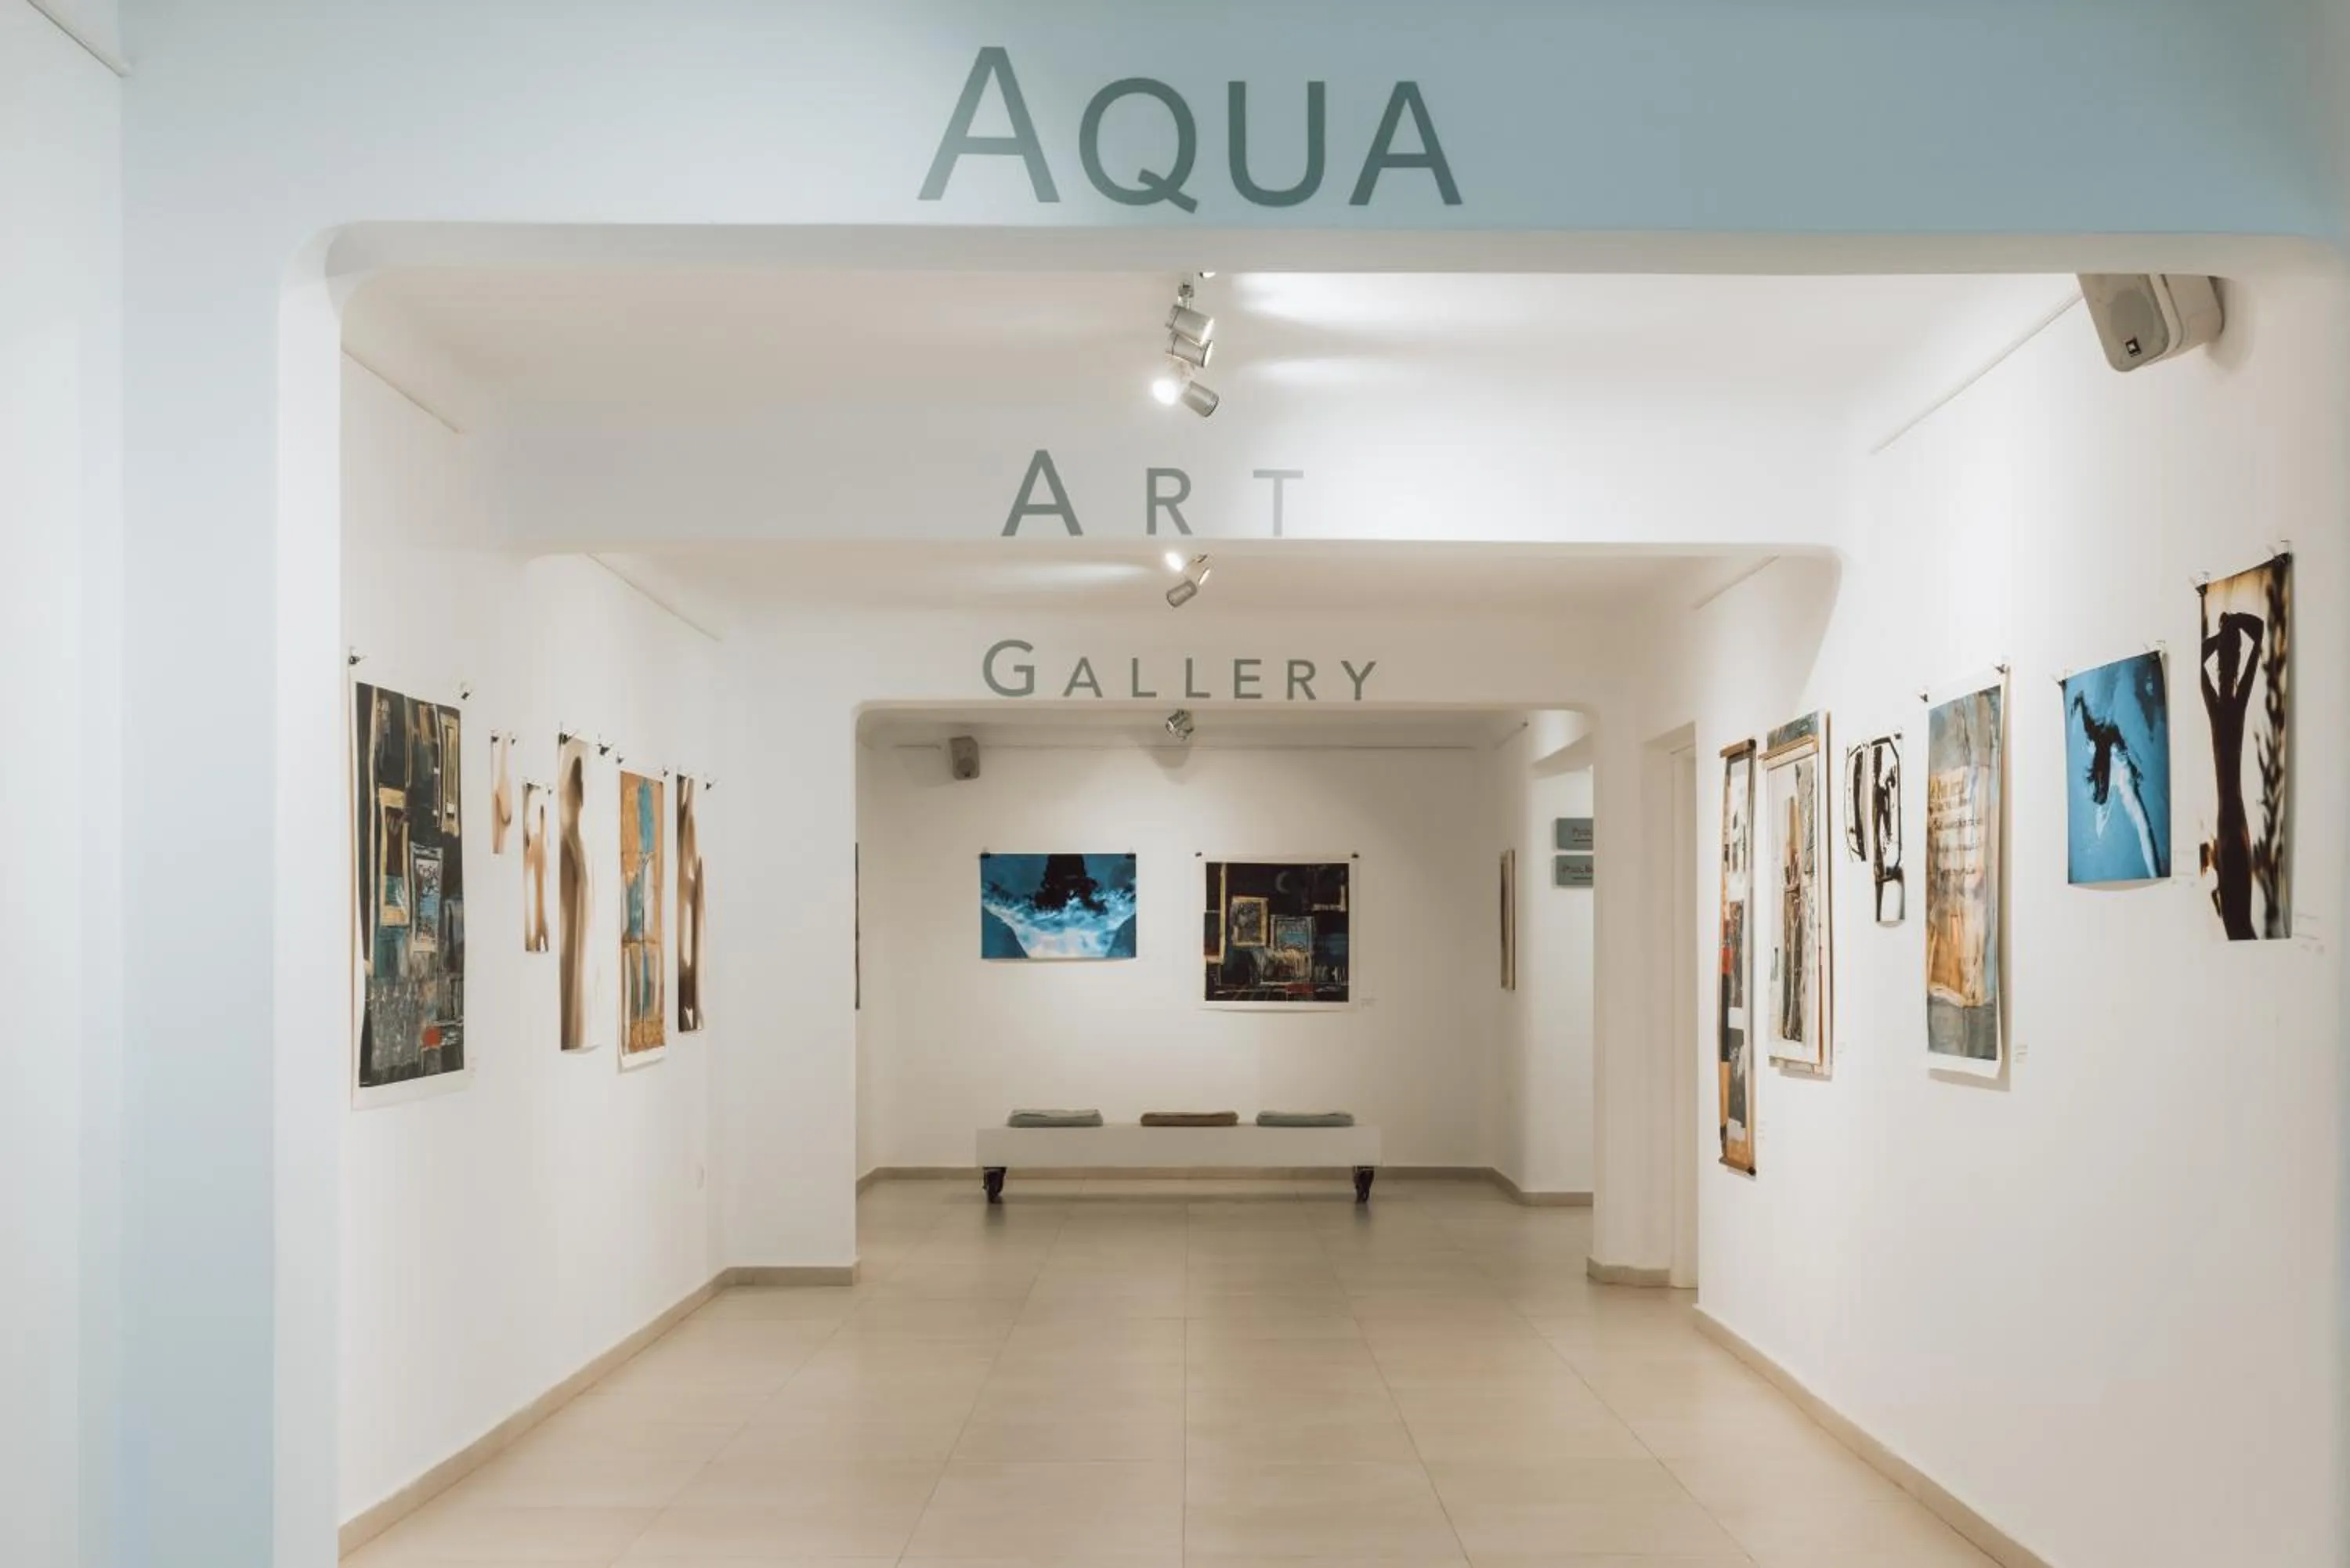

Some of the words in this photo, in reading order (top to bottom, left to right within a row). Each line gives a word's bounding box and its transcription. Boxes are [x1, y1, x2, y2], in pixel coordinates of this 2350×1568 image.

[917, 46, 1462, 213] AQUA
[1001, 450, 1304, 537] ART
[982, 639, 1376, 700] GALLERY
